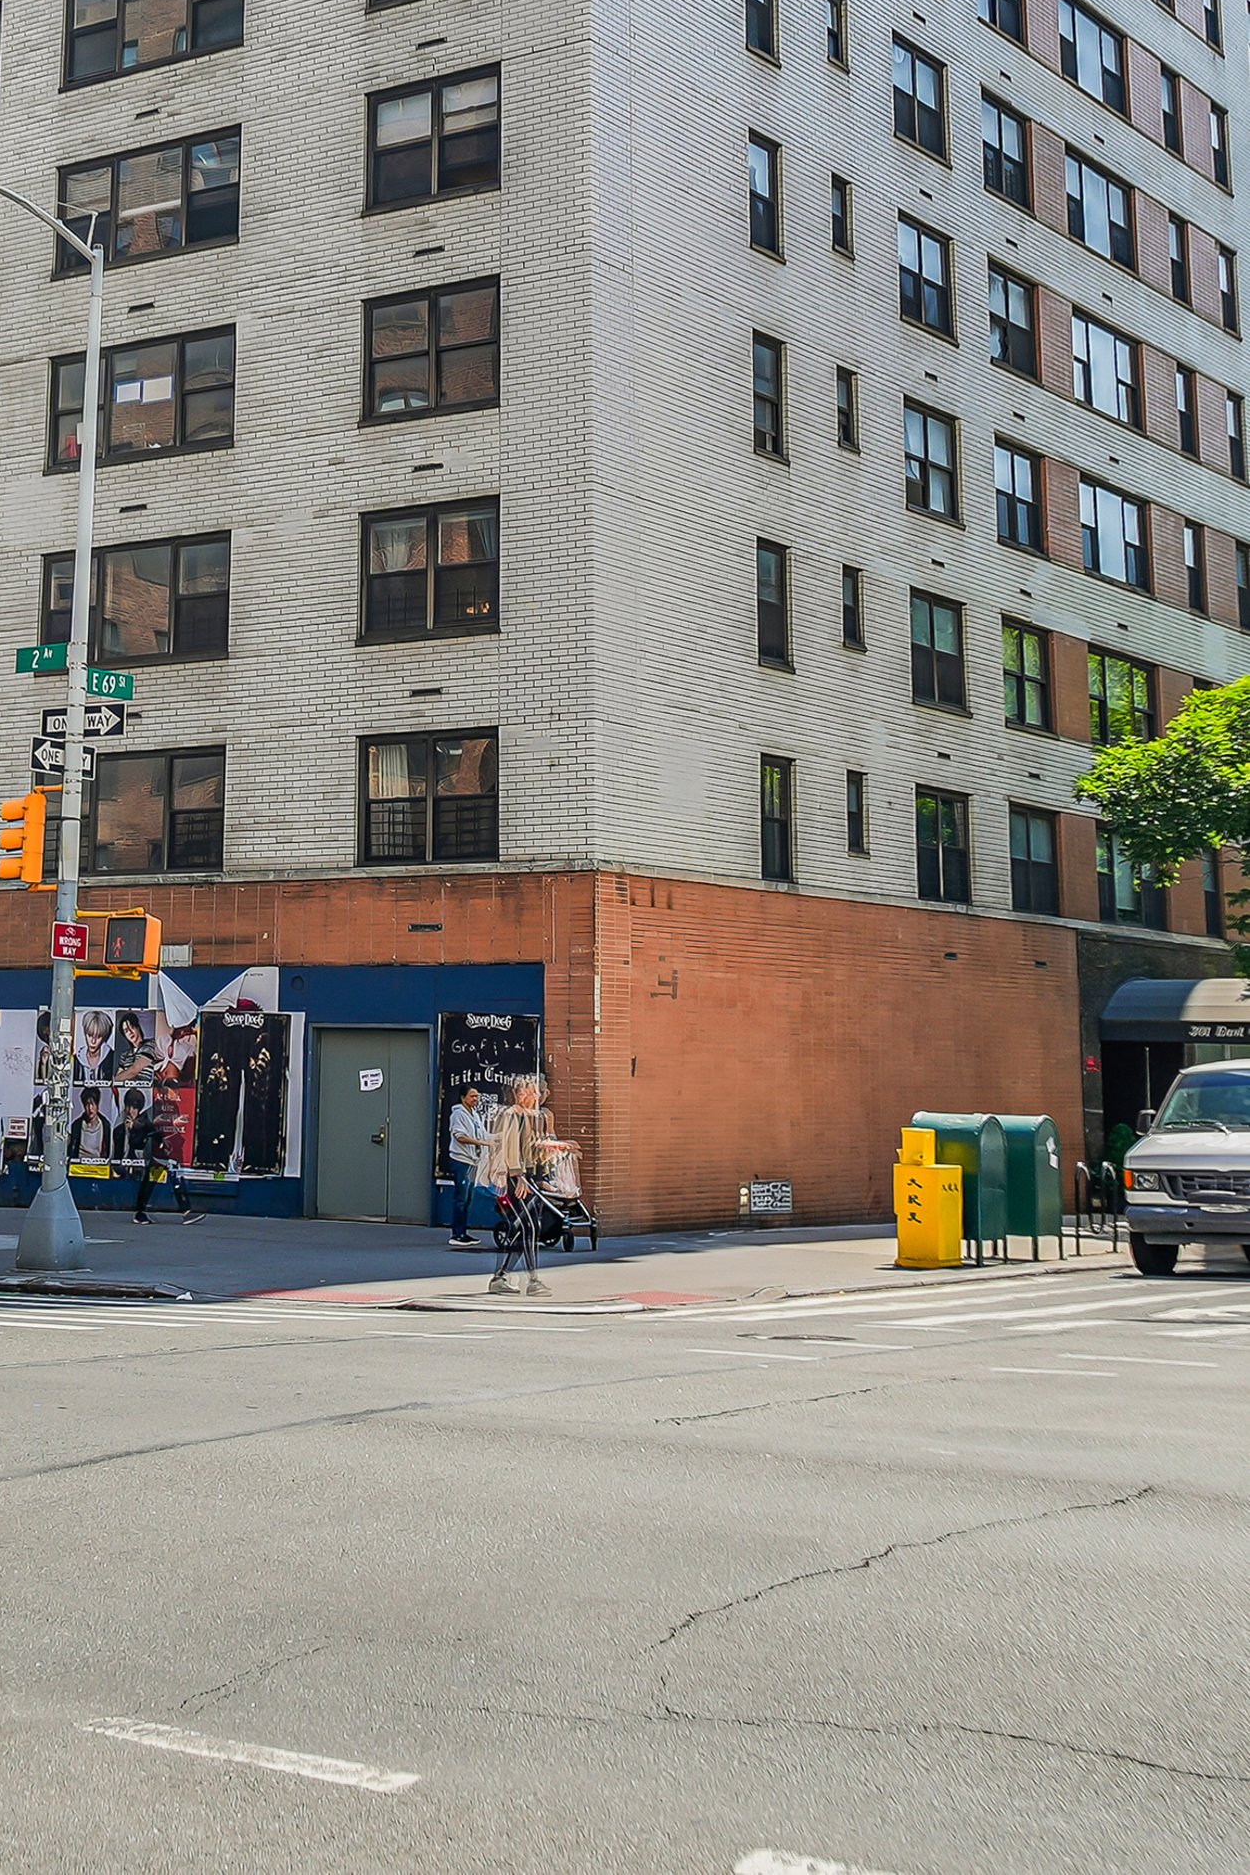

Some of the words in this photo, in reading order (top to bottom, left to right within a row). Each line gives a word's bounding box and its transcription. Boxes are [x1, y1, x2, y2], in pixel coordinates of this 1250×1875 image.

[31, 650, 40, 668] 2
[42, 647, 53, 659] Av
[92, 672, 99, 692] E
[102, 675, 116, 694] 69
[53, 716, 67, 730] ON
[87, 714, 112, 727] WAY
[41, 748, 61, 764] ONE
[58, 935, 82, 947] WRONG
[62, 946, 77, 956] WAY
[1215, 1025, 1245, 1037] East
